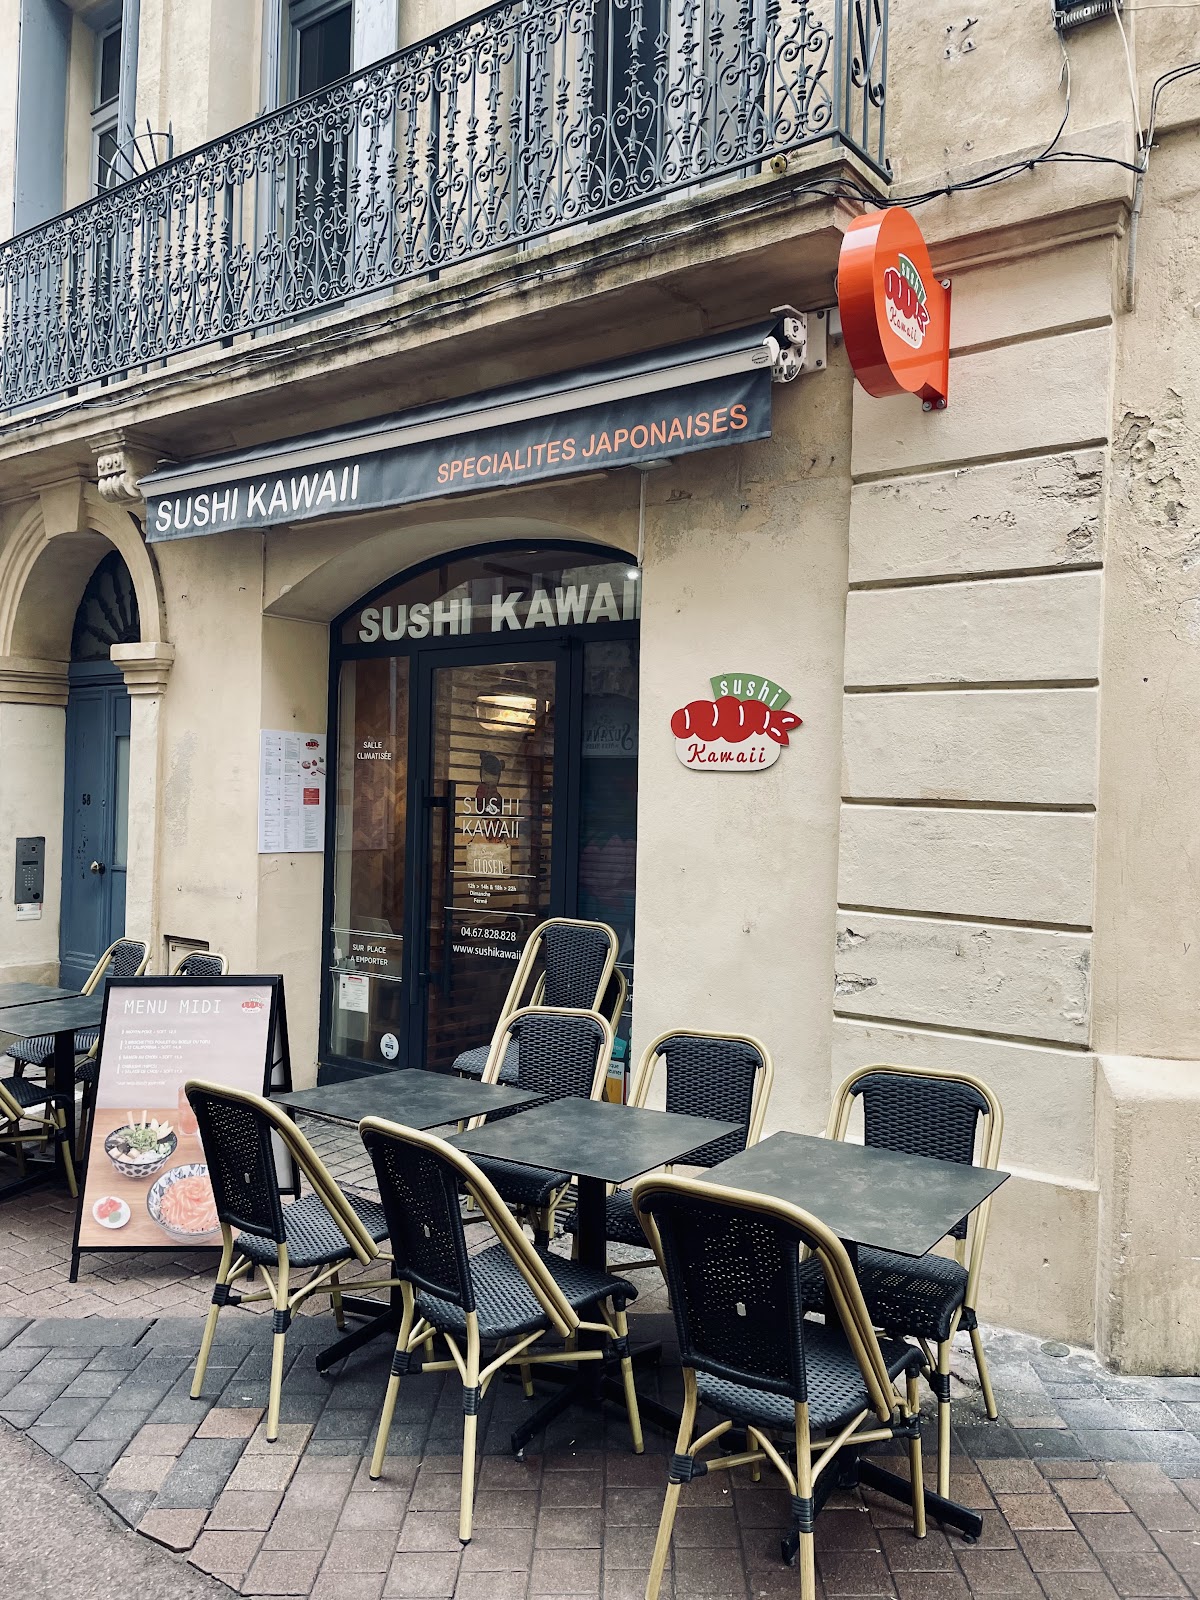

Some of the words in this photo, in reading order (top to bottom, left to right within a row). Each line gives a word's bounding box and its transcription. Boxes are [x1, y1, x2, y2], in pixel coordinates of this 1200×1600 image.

[901, 262, 923, 299] sushi
[889, 306, 917, 342] Kawaii
[437, 438, 576, 483] SPECIALITES
[582, 404, 748, 457] JAPONAISES
[155, 487, 239, 531] SUSHI
[247, 464, 360, 518] KAWAII
[359, 597, 472, 642] SUSHI
[720, 679, 783, 707] sushi
[363, 741, 383, 749] SALLE
[687, 743, 766, 763] Kawaii
[357, 750, 392, 760] CLIMATISÉE
[82, 793, 91, 806] 58
[463, 797, 520, 815] SUSHI
[462, 819, 520, 838] KAWAII
[473, 858, 504, 874] CLOSED
[461, 926, 517, 942] 04.67.828.828
[352, 943, 364, 951] SUR
[367, 945, 387, 954] PLACE
[355, 955, 388, 966] EMPORTER
[124, 999, 168, 1014] MENU
[179, 999, 223, 1014] MIDI
